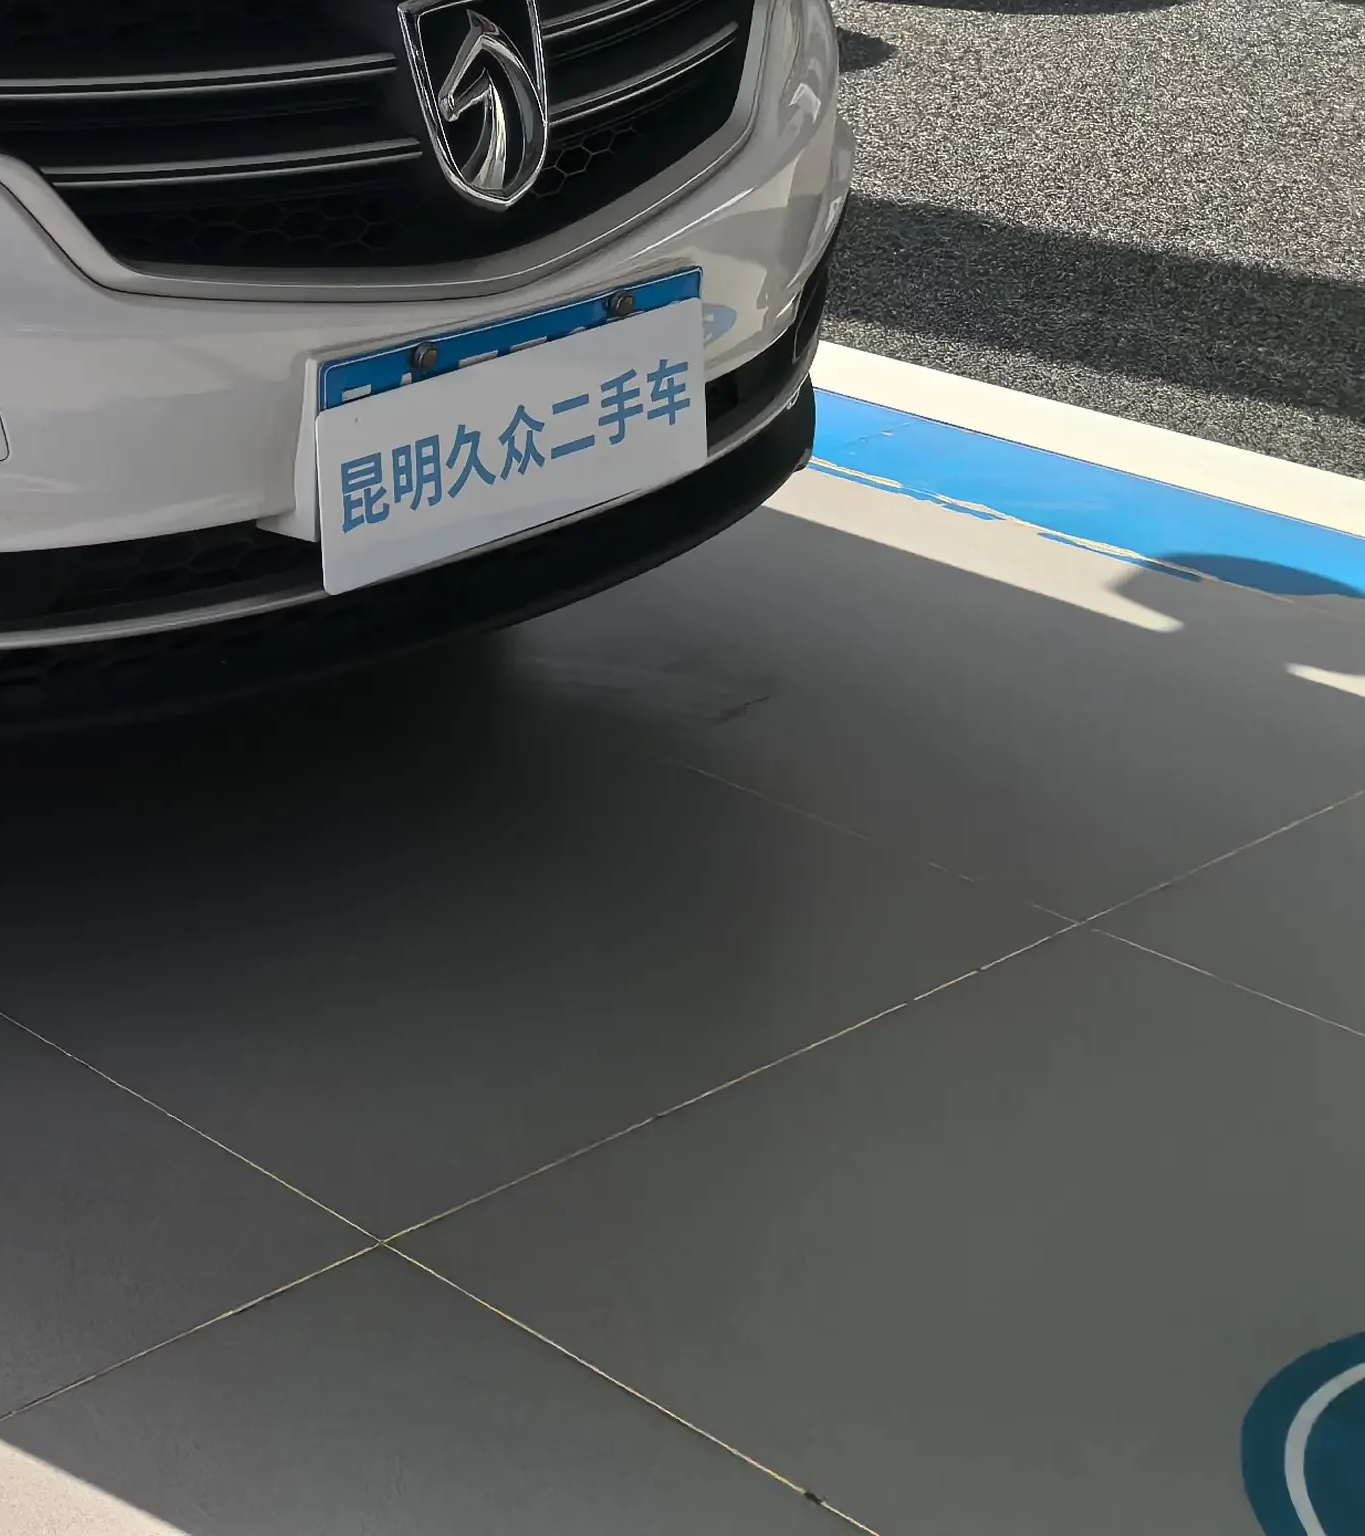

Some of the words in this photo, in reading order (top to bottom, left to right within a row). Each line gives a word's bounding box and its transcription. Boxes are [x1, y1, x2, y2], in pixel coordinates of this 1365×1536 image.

[341, 358, 690, 535] 昆明久众二手车
